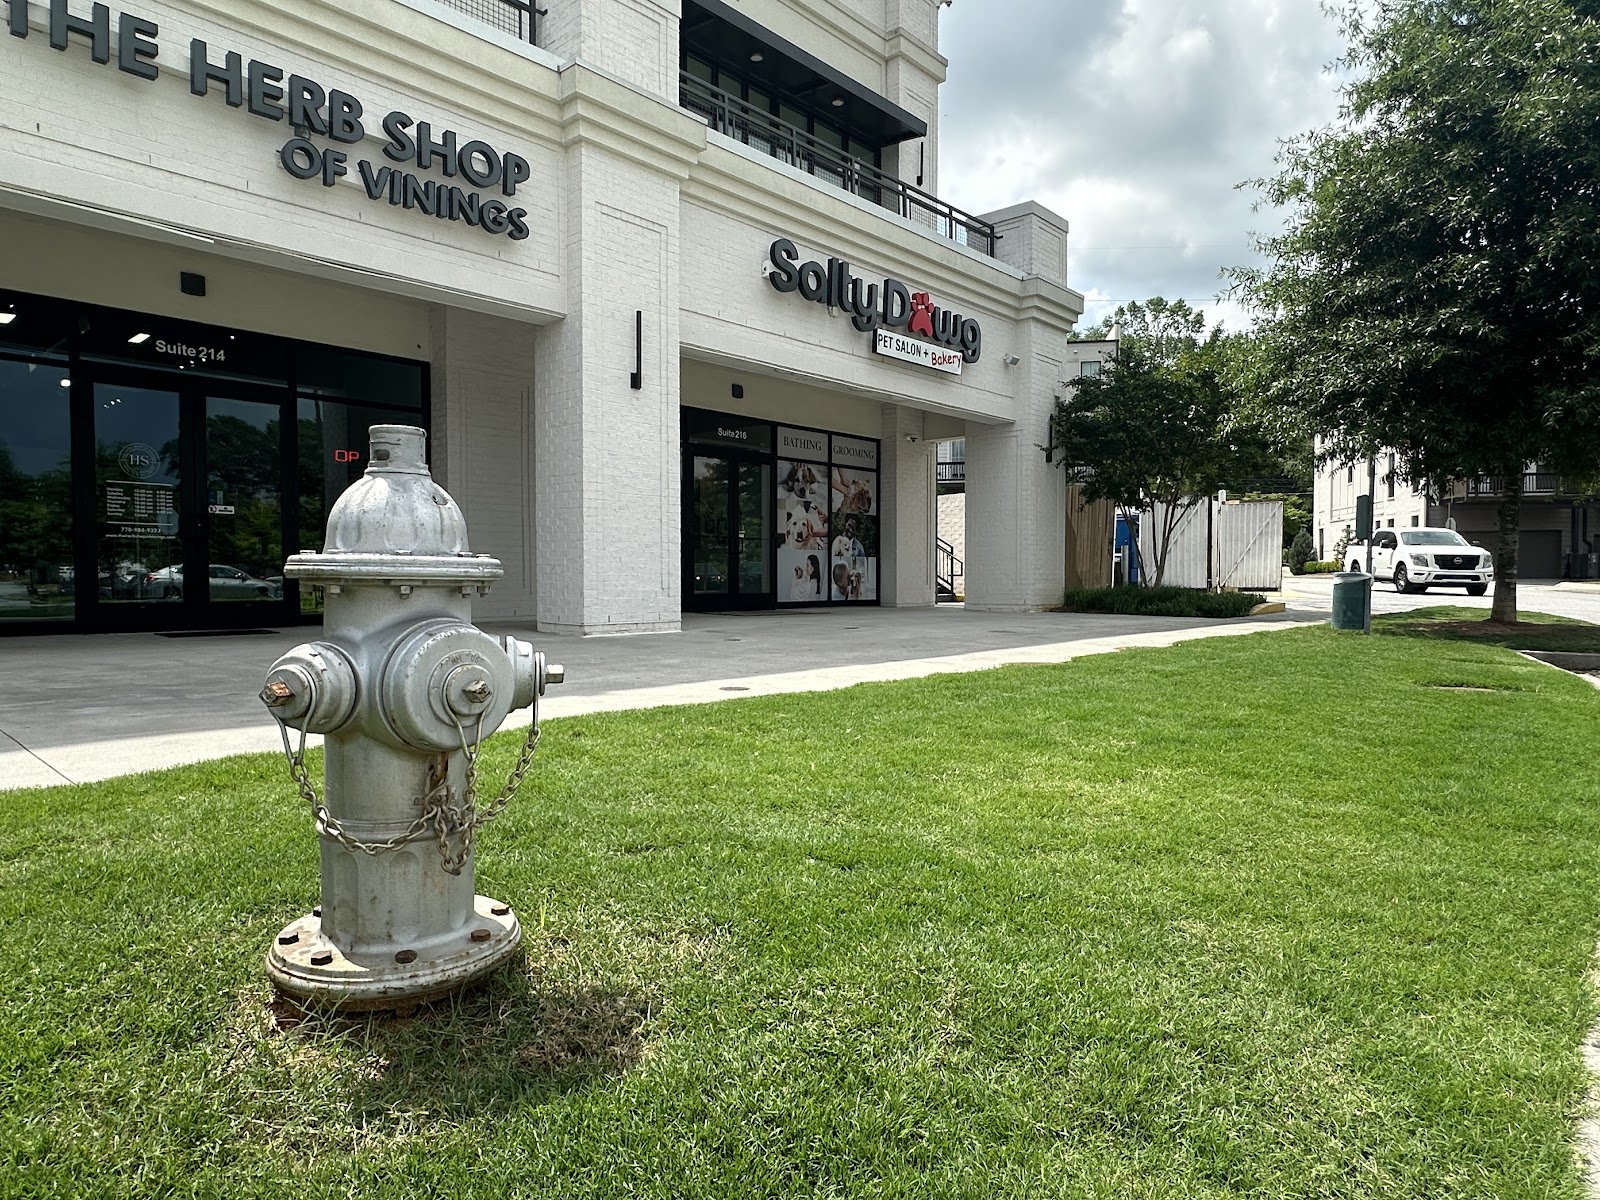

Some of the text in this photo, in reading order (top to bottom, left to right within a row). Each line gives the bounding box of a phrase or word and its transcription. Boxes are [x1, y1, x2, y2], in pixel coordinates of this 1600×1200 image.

[190, 38, 365, 144] HERB
[381, 110, 531, 196] SHOP
[279, 138, 530, 241] OF VININGS
[769, 238, 878, 333] Salty
[155, 340, 226, 362] Suite 214
[878, 333, 893, 349] PET
[895, 338, 922, 358] SALON
[931, 351, 962, 369] Bakery
[717, 427, 748, 440] Suite 216
[783, 435, 822, 452] BATHING
[832, 444, 874, 460] GROOMING
[129, 454, 150, 466] HS
[335, 449, 360, 462] OP
